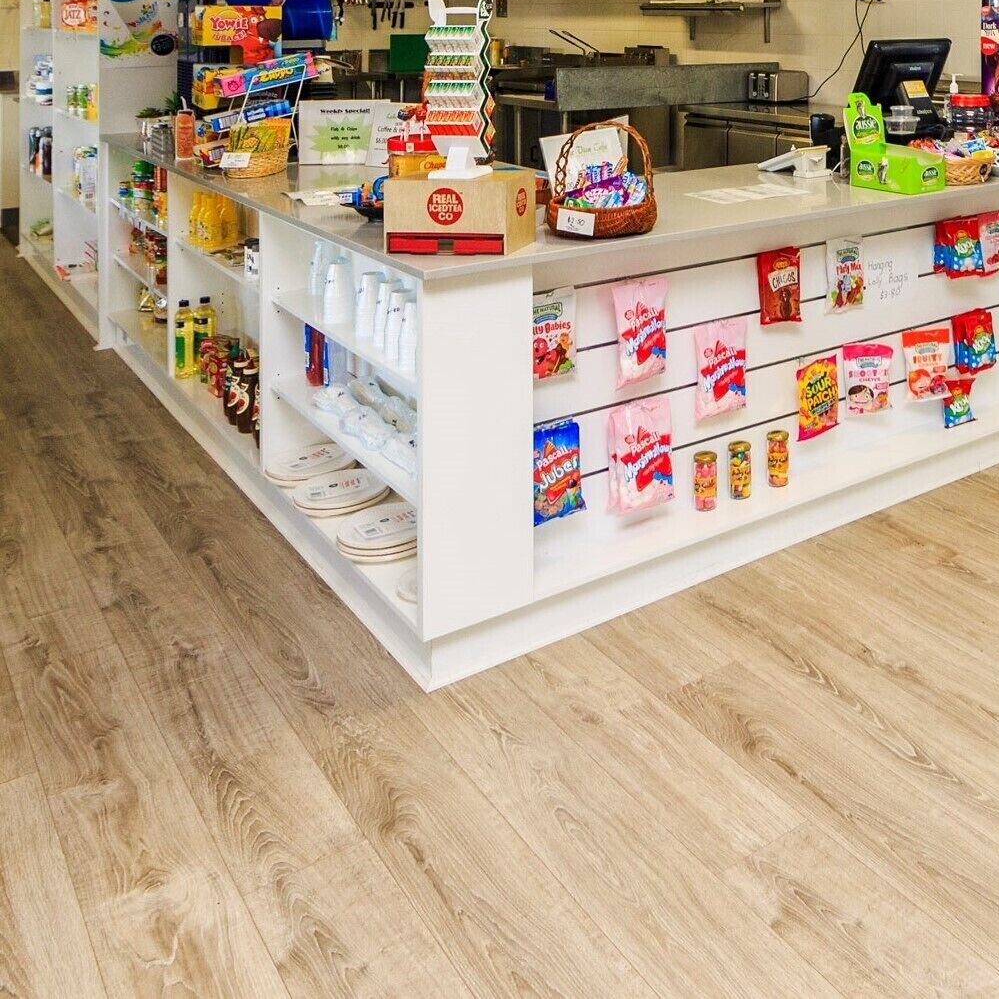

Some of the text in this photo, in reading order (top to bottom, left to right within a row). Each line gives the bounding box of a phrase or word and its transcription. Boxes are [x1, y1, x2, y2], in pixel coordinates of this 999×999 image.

[210, 16, 248, 31] YOWIE
[432, 193, 459, 204] REAL
[438, 212, 454, 221] CO
[544, 321, 571, 334] Babies
[630, 307, 659, 328] Pascall
[805, 377, 833, 397] SOUR
[807, 386, 836, 409] PATCH
[630, 431, 661, 456] Pascall
[536, 445, 569, 472] Pascall
